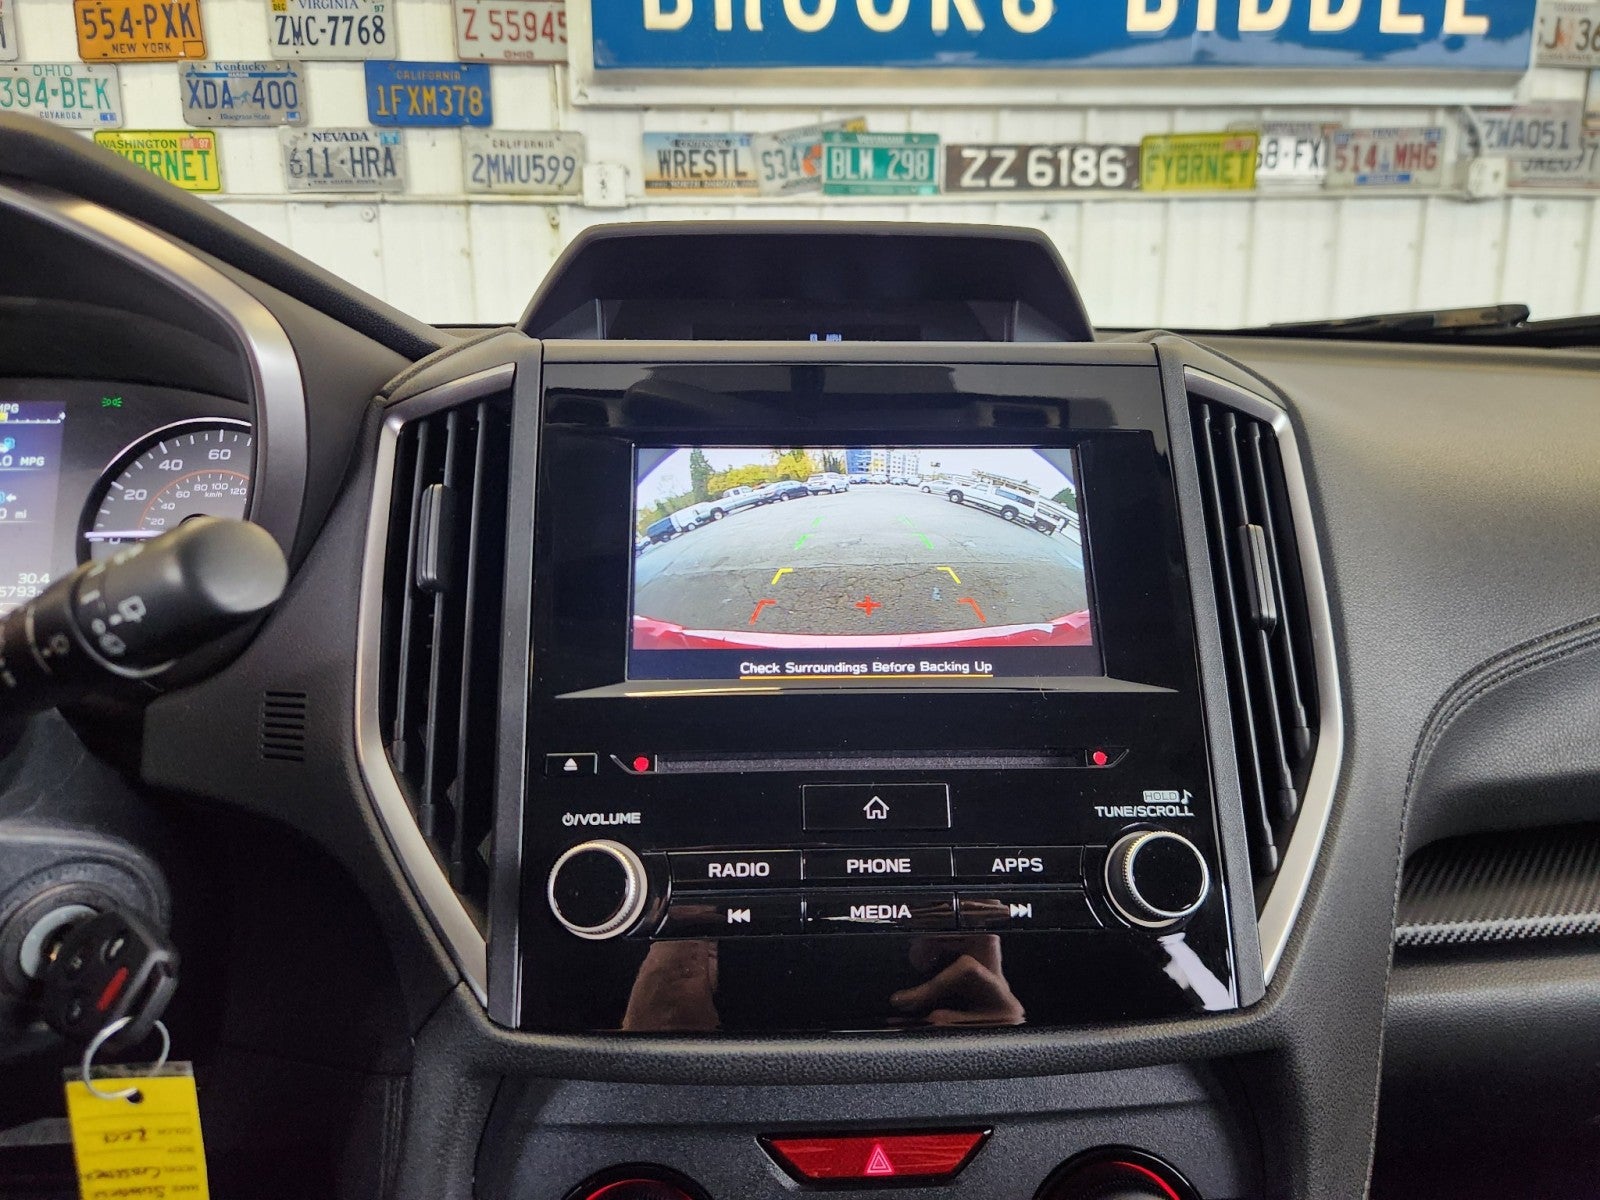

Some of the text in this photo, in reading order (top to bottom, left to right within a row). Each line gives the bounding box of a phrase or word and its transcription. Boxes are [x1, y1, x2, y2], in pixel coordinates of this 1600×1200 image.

[82, 3, 195, 40] 554-PXK
[463, 8, 478, 40] Z
[275, 15, 385, 46] ZMC-7768
[112, 43, 171, 53] NEW YORK
[33, 64, 73, 77] OHIO
[215, 61, 268, 72] Kentucky
[397, 70, 461, 80] CALIFORNIA
[187, 79, 298, 110] XDA 400
[376, 84, 484, 117] 1FXM378
[39, 111, 82, 119] CUYAHOGA
[312, 132, 369, 143] NEVADA
[492, 139, 555, 149] CALIFORNIA
[472, 153, 576, 185] 2MWU599
[656, 148, 748, 179] WRESTL
[887, 150, 929, 180] 298
[960, 148, 1126, 188] ZZ 6186
[1147, 151, 1250, 185] FYBRNET
[208, 448, 231, 460] 60
[20, 456, 45, 467] MPG
[158, 459, 183, 471] 40
[193, 483, 208, 491] 80
[211, 482, 229, 490] 100
[230, 487, 247, 496] 120
[123, 488, 148, 501] 20
[175, 491, 191, 499] 60
[160, 502, 176, 511] 40
[15, 509, 28, 519] mi
[149, 517, 165, 526] 20
[17, 572, 51, 585] 30.4
[739, 660, 993, 675] Check Surroundings Before Backing Up
[1144, 791, 1178, 801] HOLD
[1094, 805, 1196, 818] TUNE/SCROLL
[708, 862, 770, 878] RADIO
[846, 857, 912, 874] PHONE
[991, 857, 1044, 873] APPS
[850, 903, 913, 920] MEDIA
